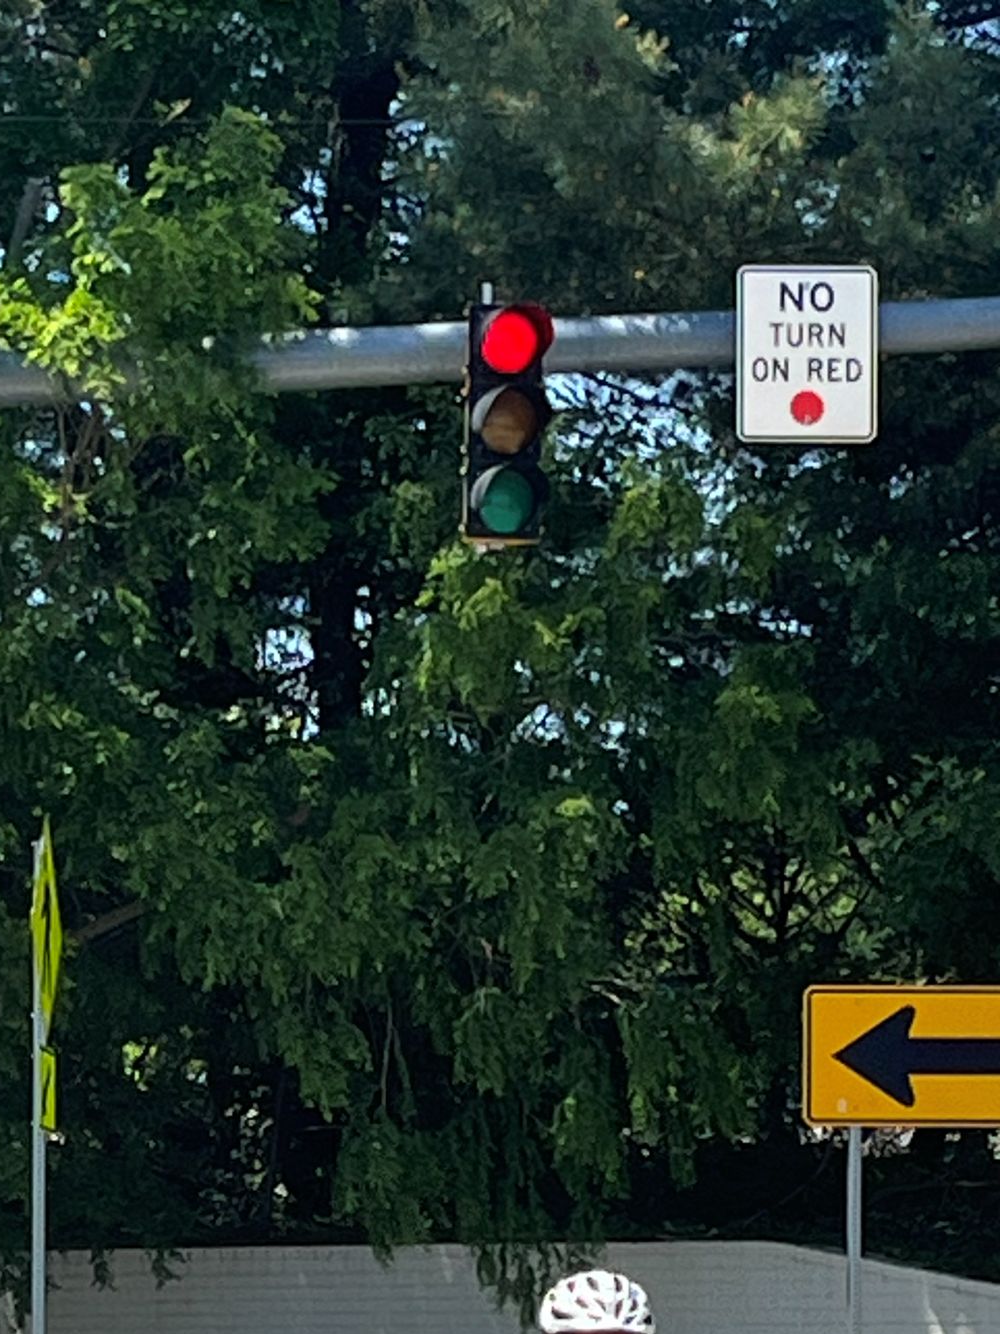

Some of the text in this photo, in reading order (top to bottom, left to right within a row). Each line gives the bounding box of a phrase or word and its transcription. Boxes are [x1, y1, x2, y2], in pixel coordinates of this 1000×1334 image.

[779, 281, 835, 312] NO
[769, 322, 846, 348] TURN
[752, 357, 863, 383] ON RED
